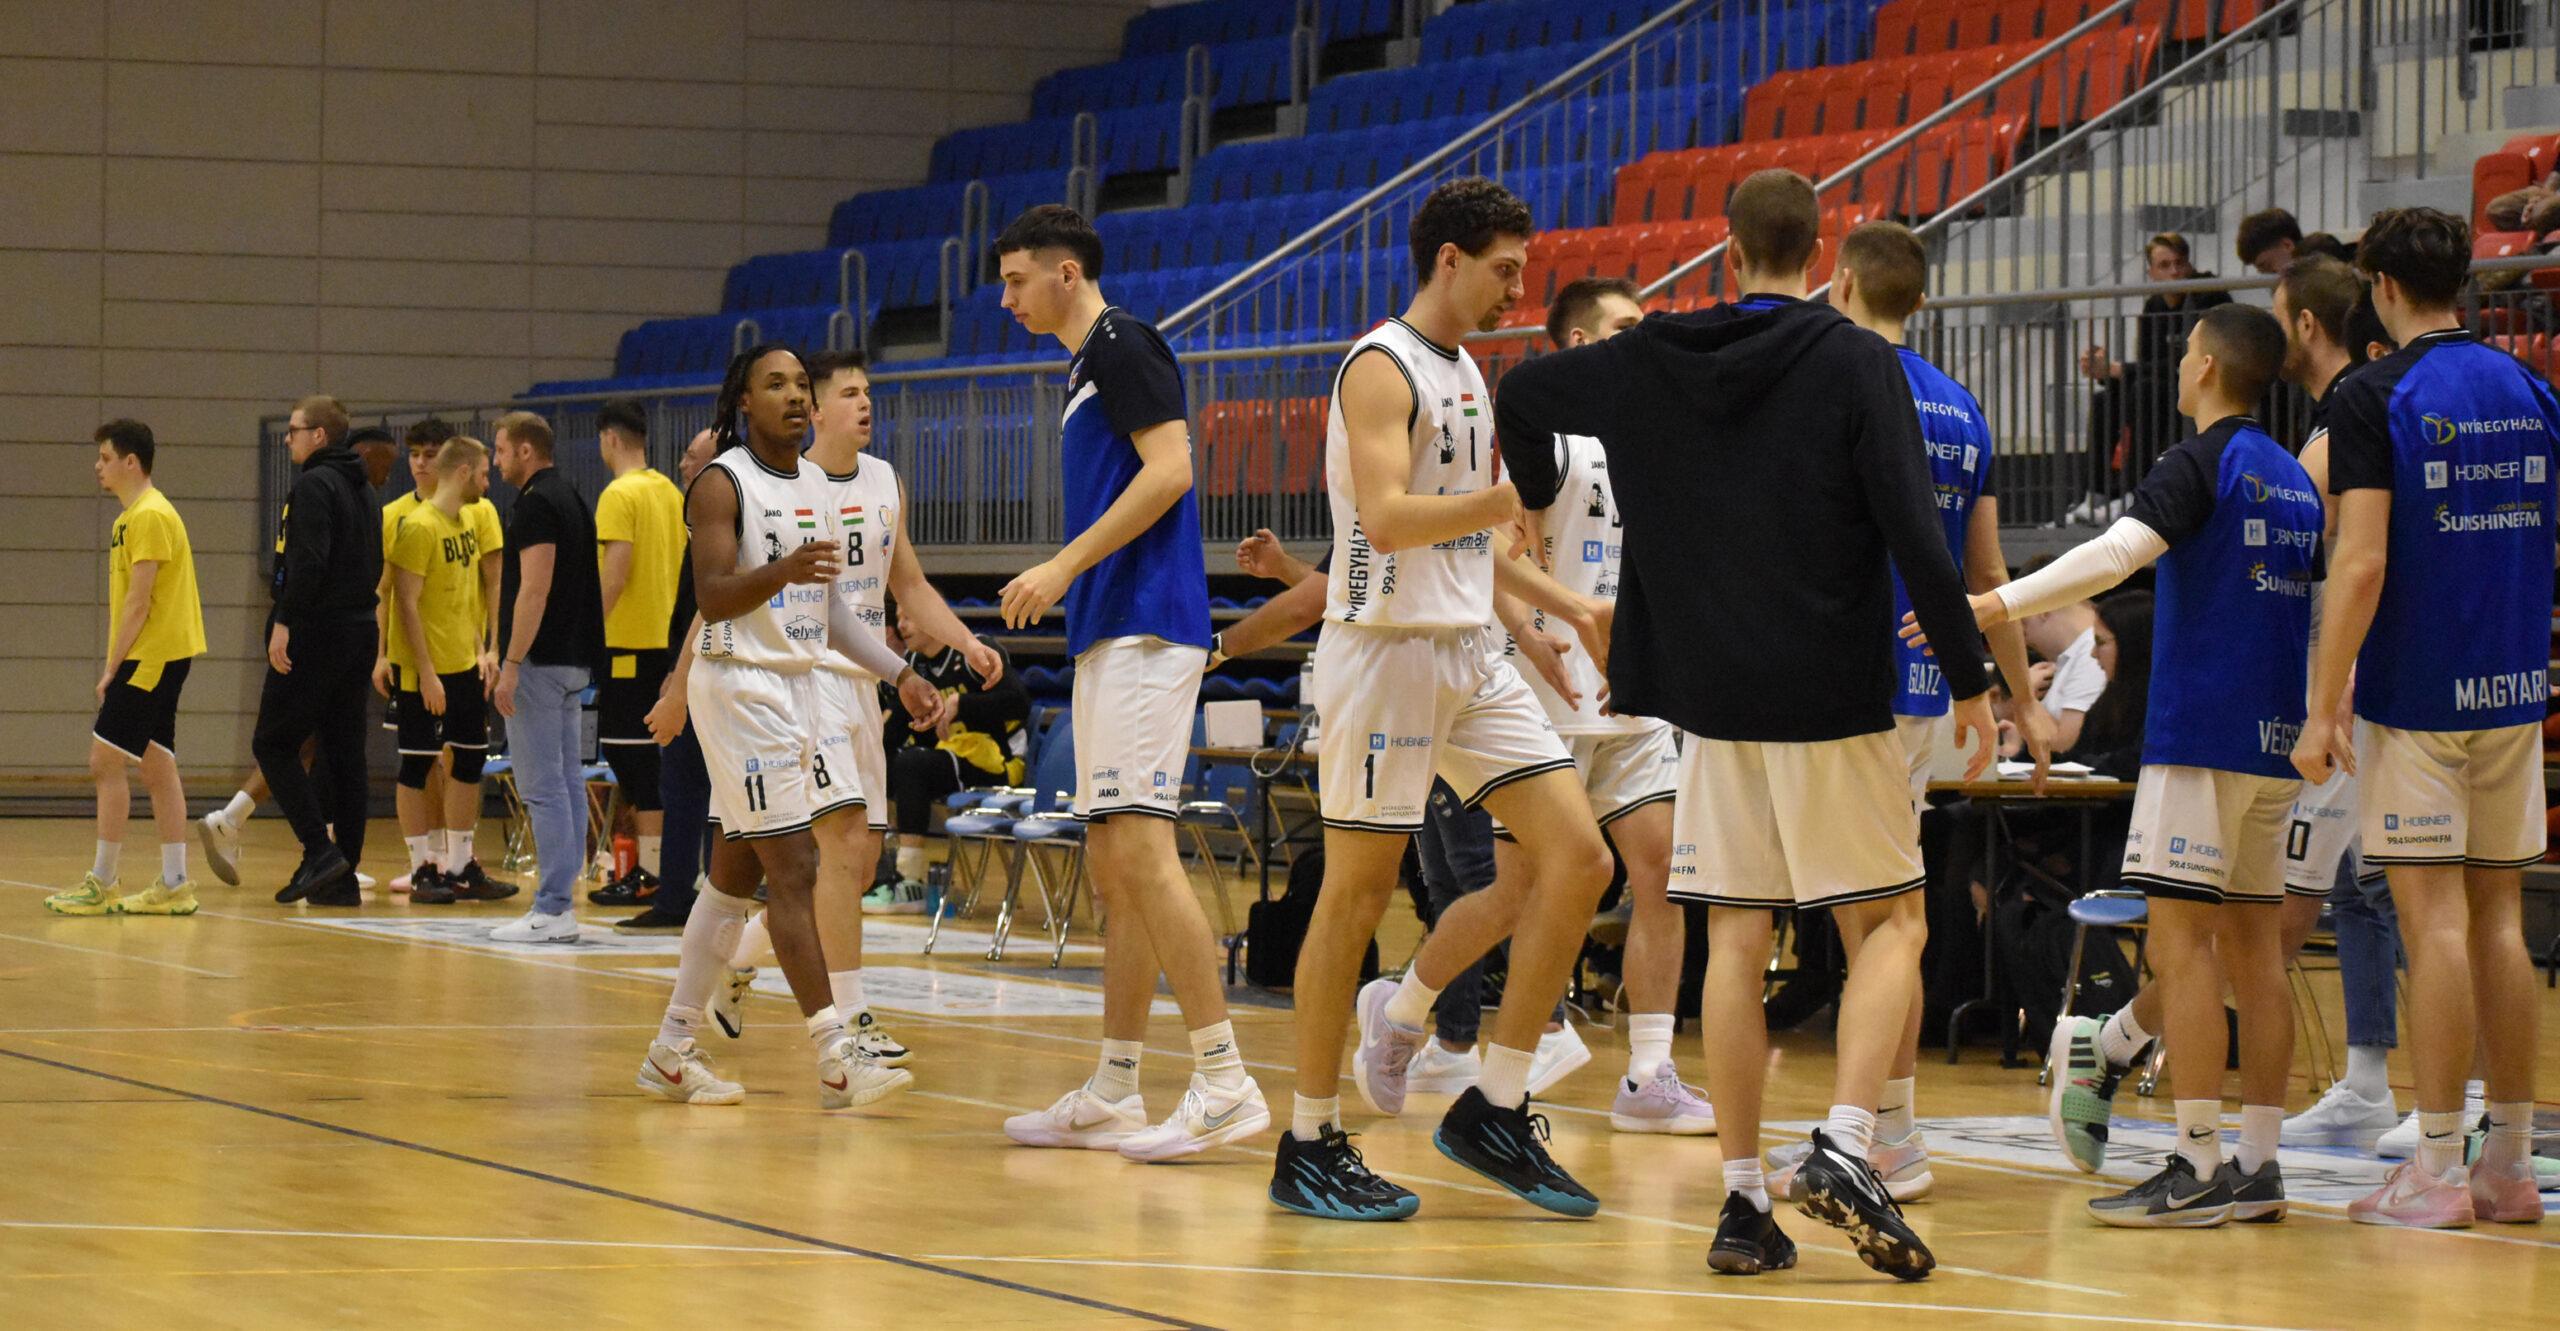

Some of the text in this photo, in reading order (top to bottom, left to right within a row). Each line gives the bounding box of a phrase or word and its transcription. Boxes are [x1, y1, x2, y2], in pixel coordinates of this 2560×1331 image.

[1469, 426, 1477, 472] 1
[847, 531, 865, 567] 8
[812, 753, 832, 789] 8
[1364, 753, 1375, 799] 1
[745, 774, 767, 812] 11
[1097, 788, 1120, 798] JAKO
